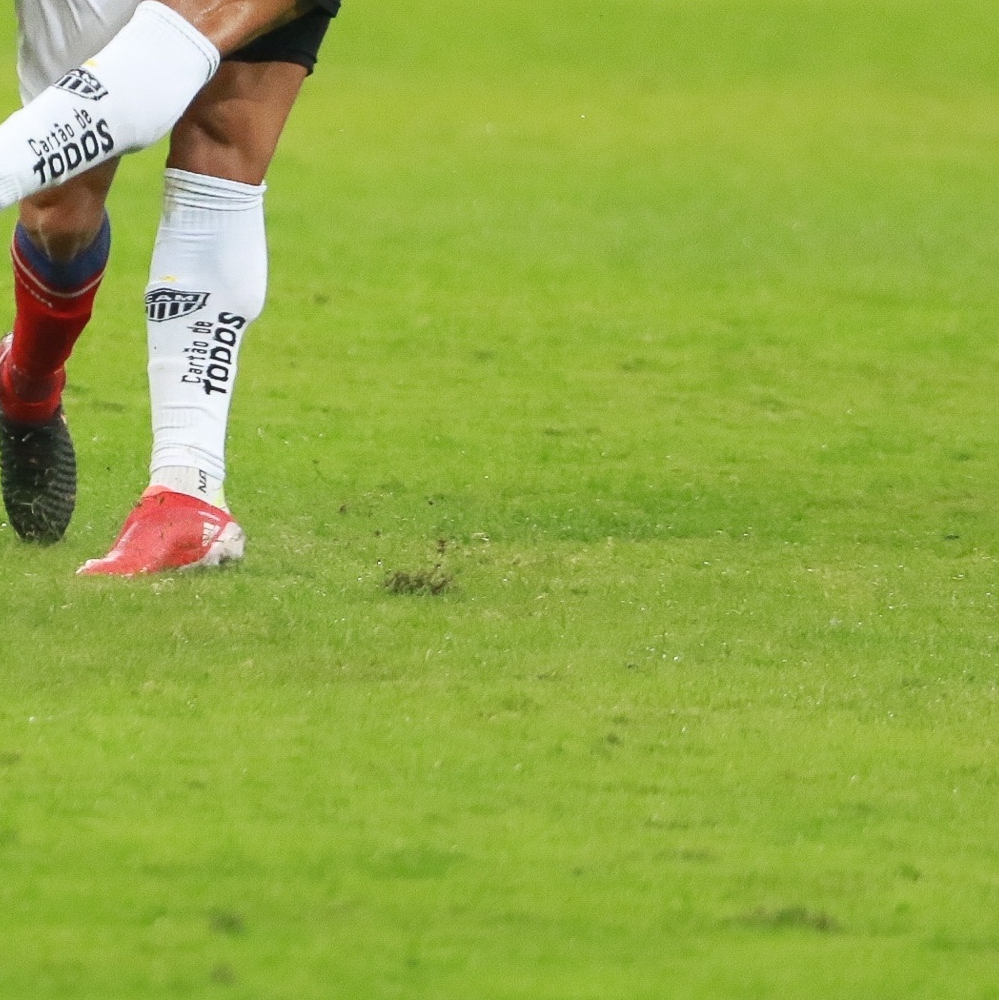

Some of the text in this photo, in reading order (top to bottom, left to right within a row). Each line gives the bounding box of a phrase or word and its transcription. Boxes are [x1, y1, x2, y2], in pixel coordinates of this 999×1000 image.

[27, 107, 93, 156] Cartão de
[33, 118, 115, 185] TODOS
[181, 321, 214, 384] Cartão de
[201, 311, 247, 396] TODOS
